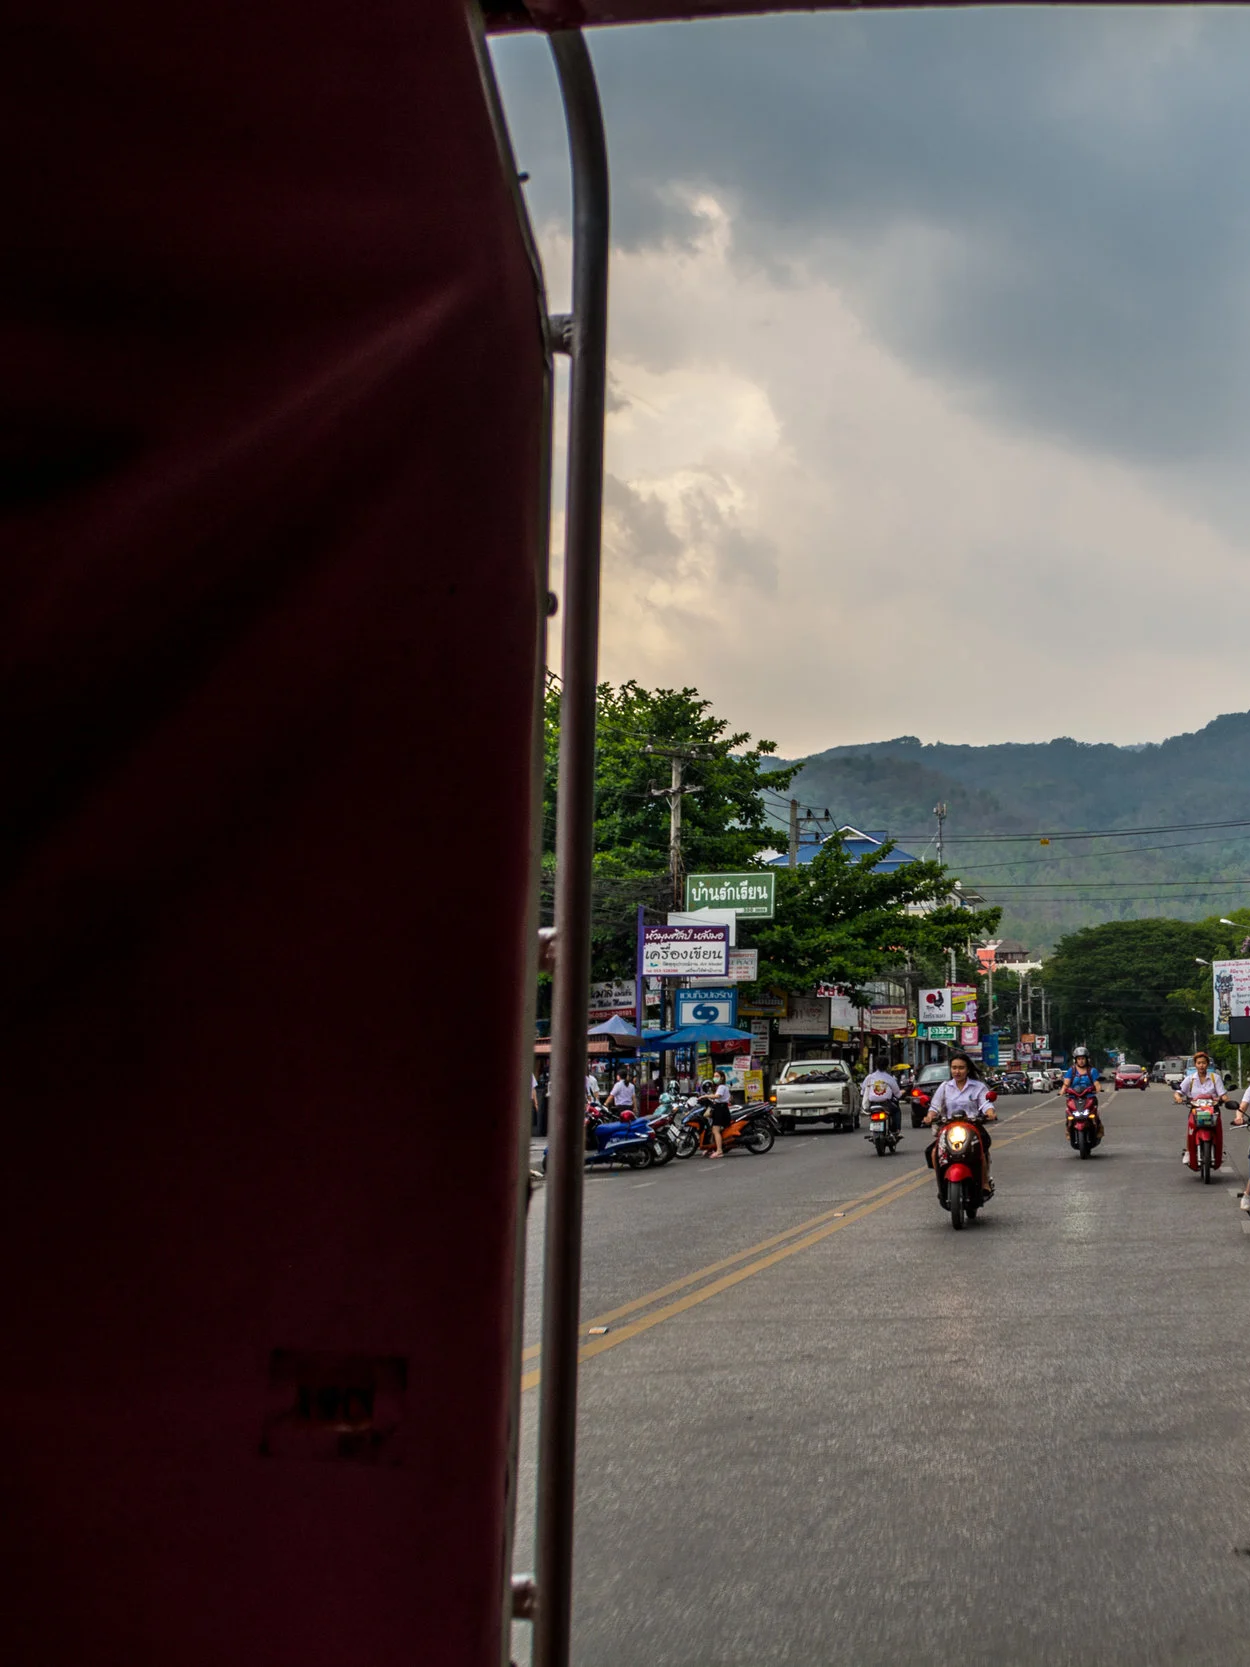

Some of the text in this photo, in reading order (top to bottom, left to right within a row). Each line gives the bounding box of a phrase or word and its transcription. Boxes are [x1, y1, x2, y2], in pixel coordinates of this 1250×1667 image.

[691, 879, 768, 901] บ้านรักเรียน
[645, 943, 723, 960] เครื่องเขียน
